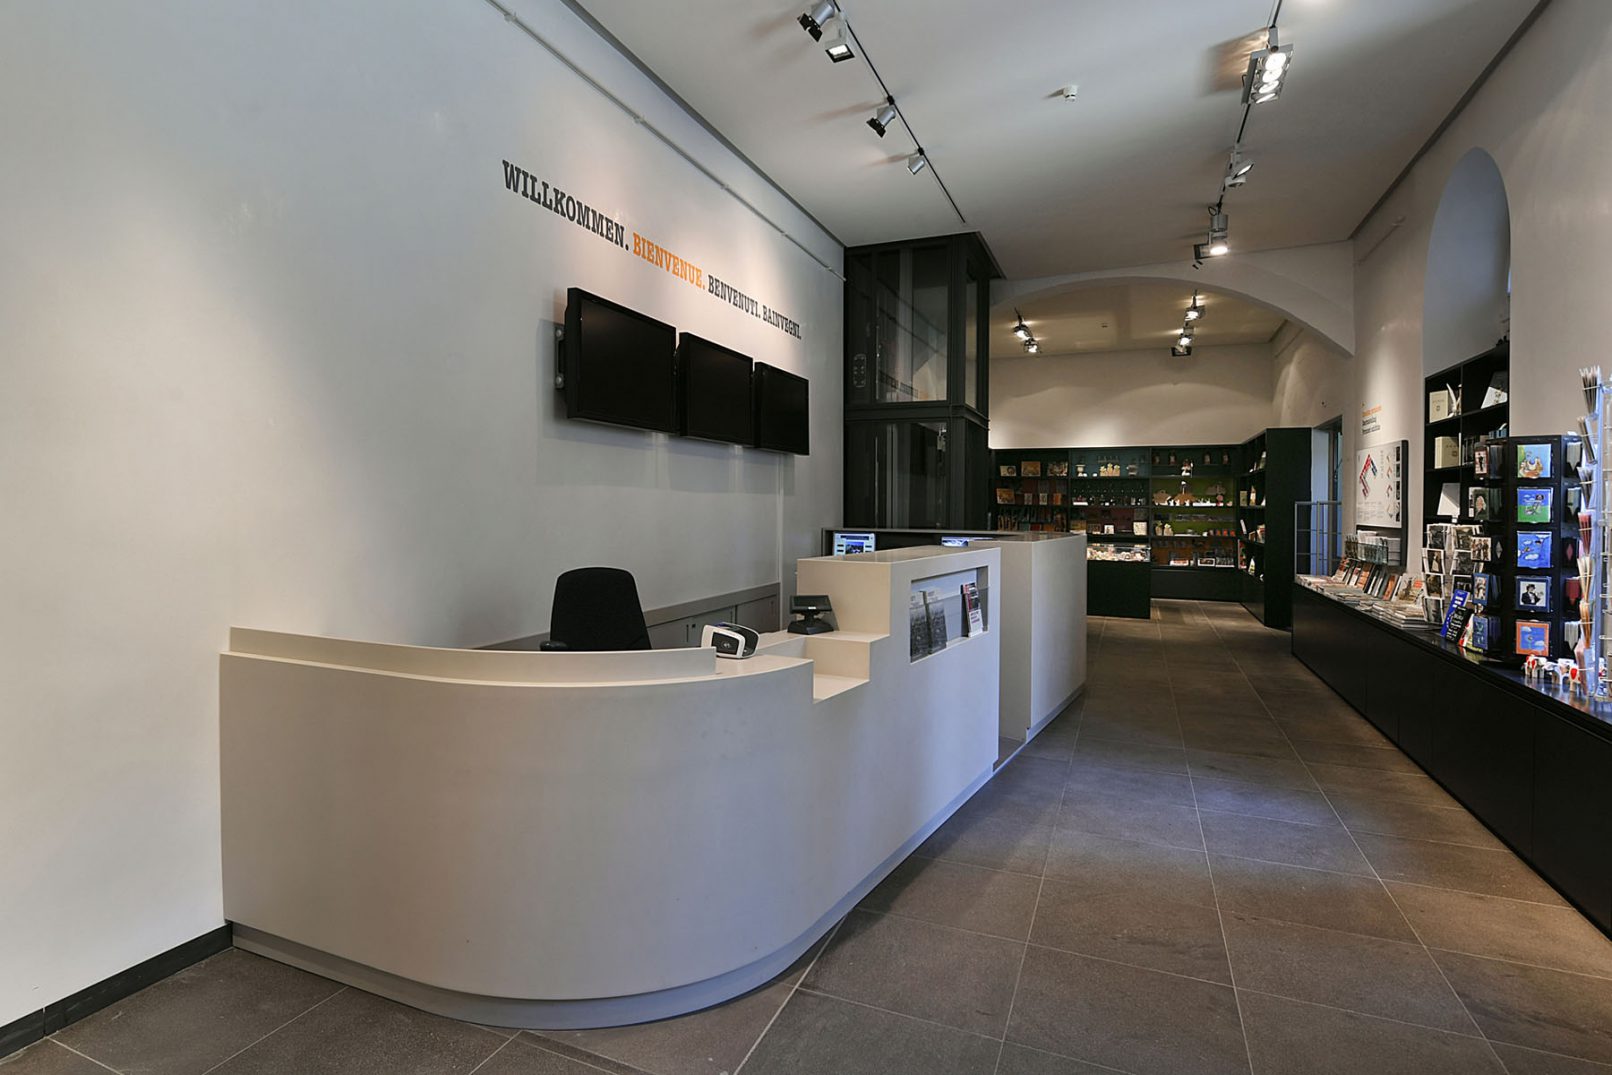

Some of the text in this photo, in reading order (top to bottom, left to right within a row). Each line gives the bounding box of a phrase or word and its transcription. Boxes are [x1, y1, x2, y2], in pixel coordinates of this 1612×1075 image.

[502, 159, 802, 340] WILLKOMMEN. BIENVENUE. BENVENUTI. BAINVEGNI.
